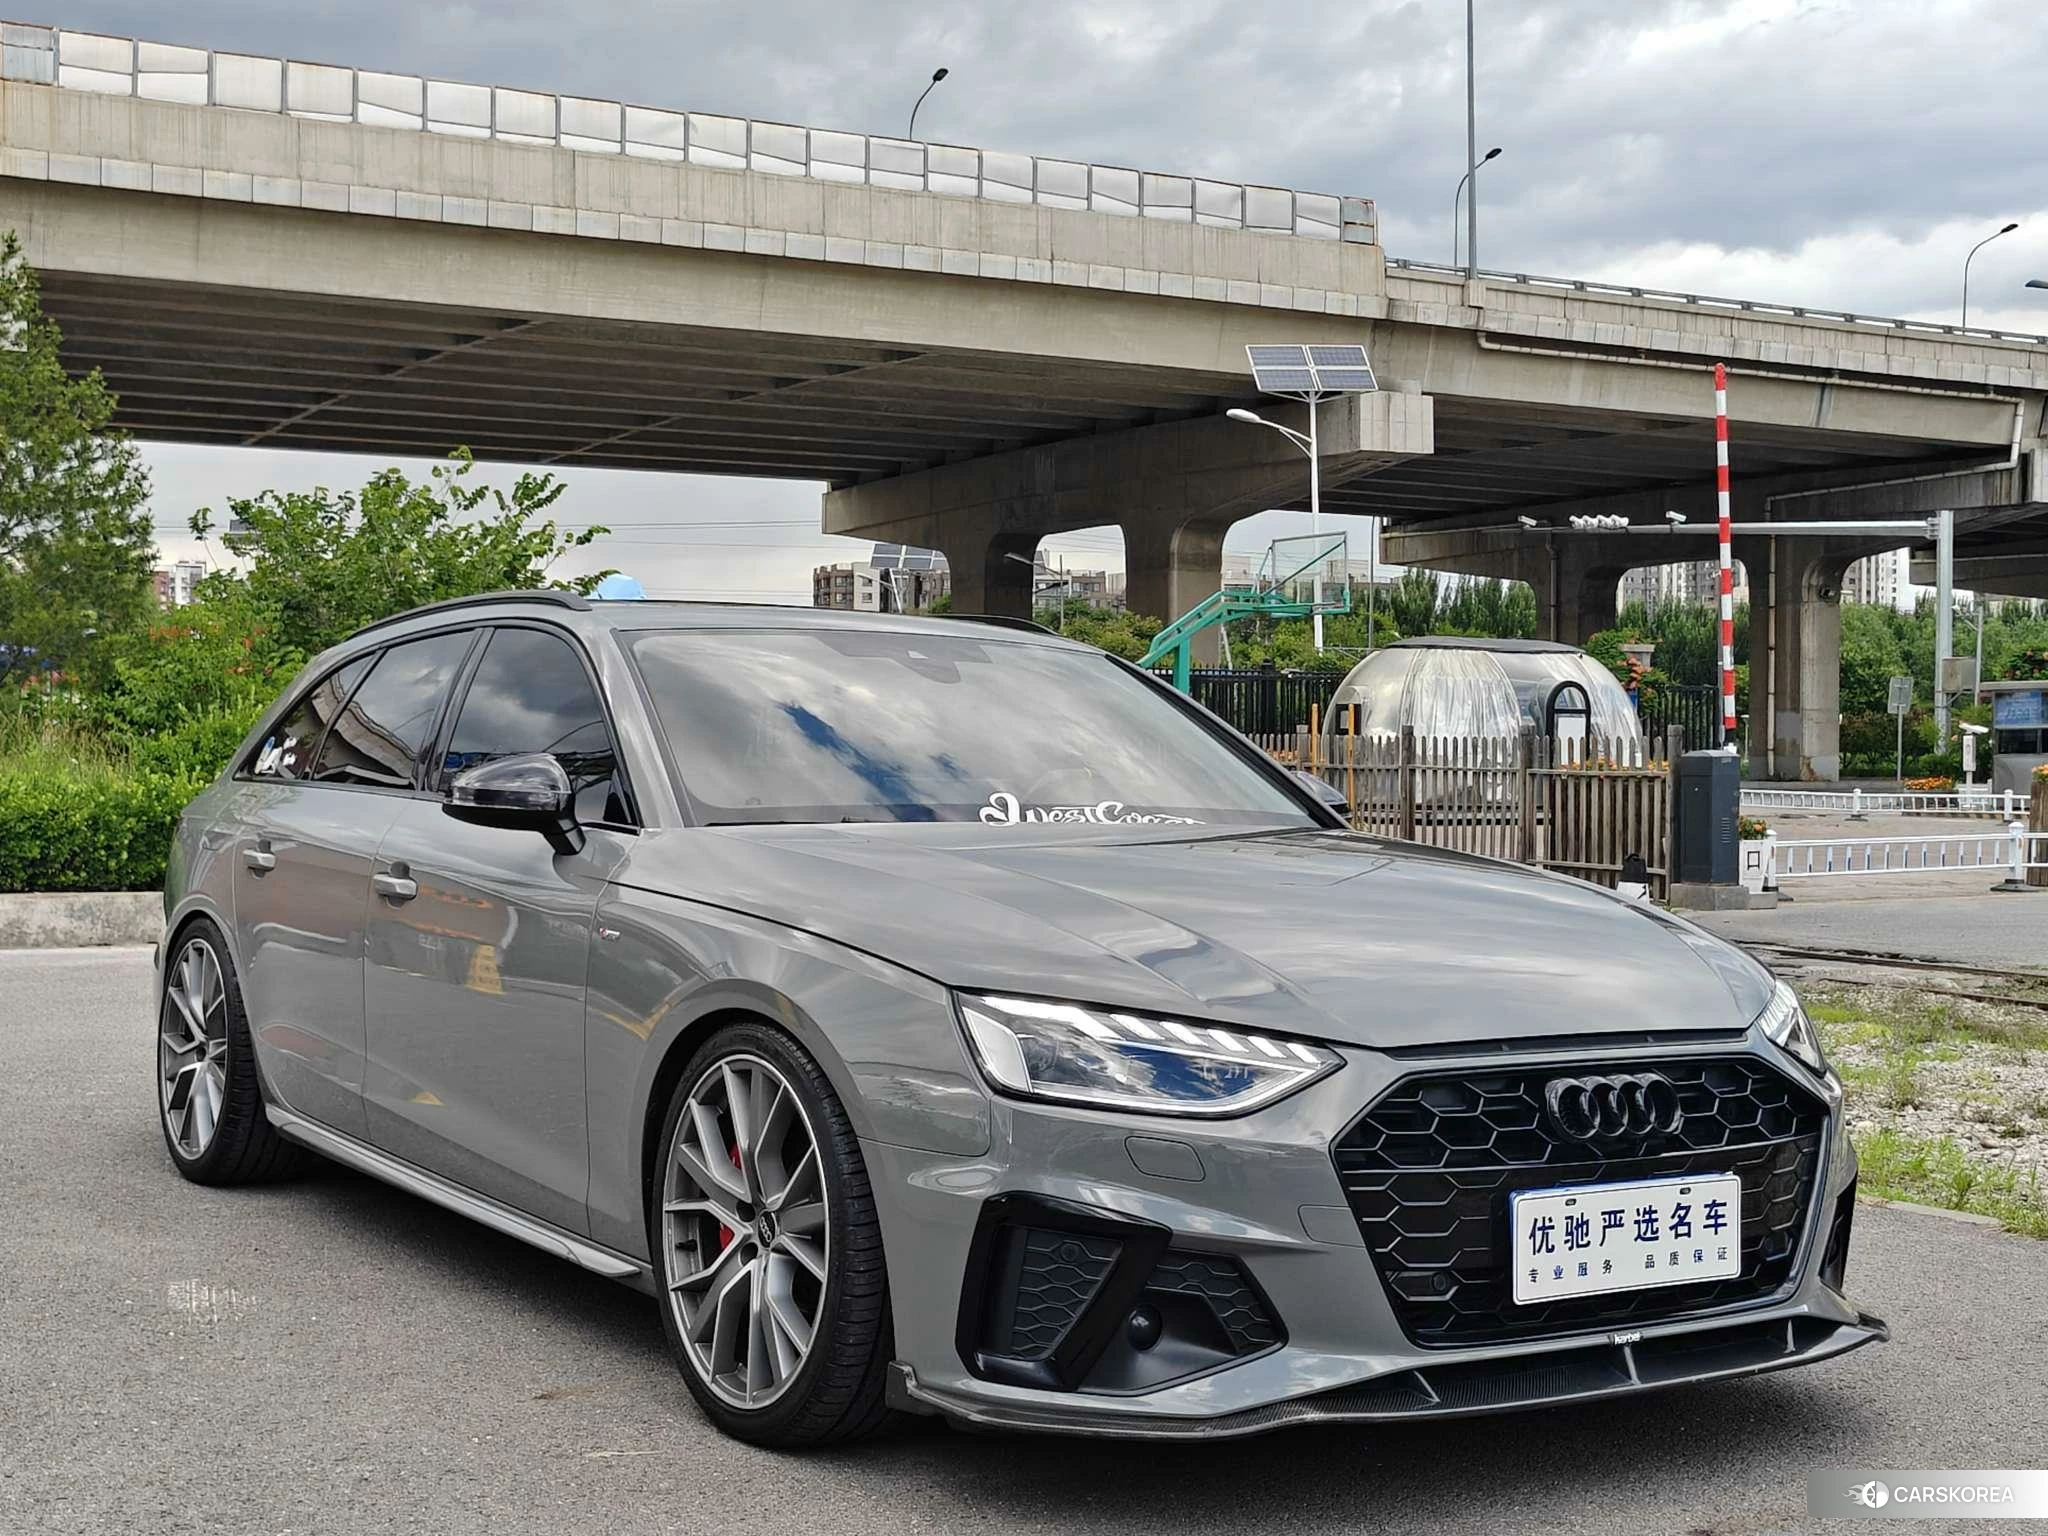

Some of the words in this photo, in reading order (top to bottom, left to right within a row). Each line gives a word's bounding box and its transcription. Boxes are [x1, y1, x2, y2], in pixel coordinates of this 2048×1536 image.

[1528, 1199, 1728, 1255] 优驰严选名车
[1528, 1254, 1614, 1282] 专业服务
[1644, 1246, 1728, 1269] 品质保证
